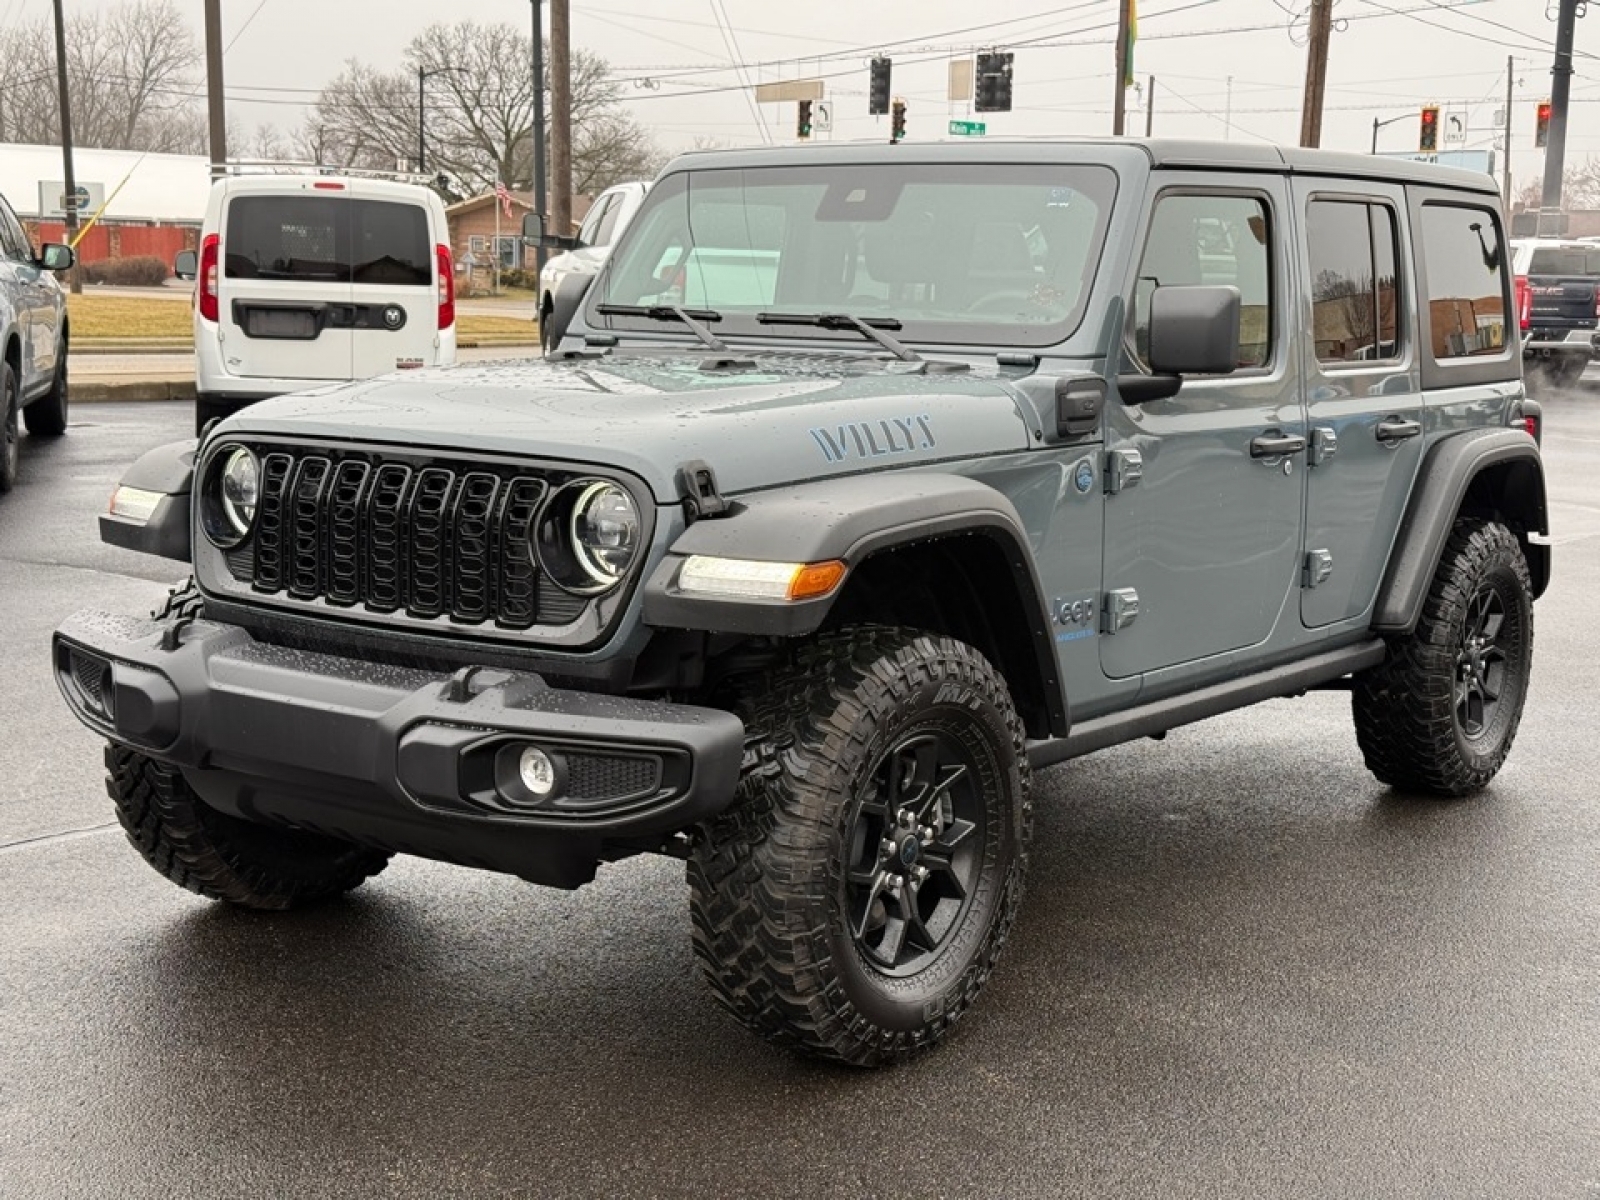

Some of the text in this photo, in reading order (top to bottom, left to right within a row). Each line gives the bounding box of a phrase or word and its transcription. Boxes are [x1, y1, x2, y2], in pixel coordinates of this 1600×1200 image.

[951, 122, 968, 134] Main
[809, 414, 935, 463] WILLYS
[1049, 597, 1093, 627] Jeep
